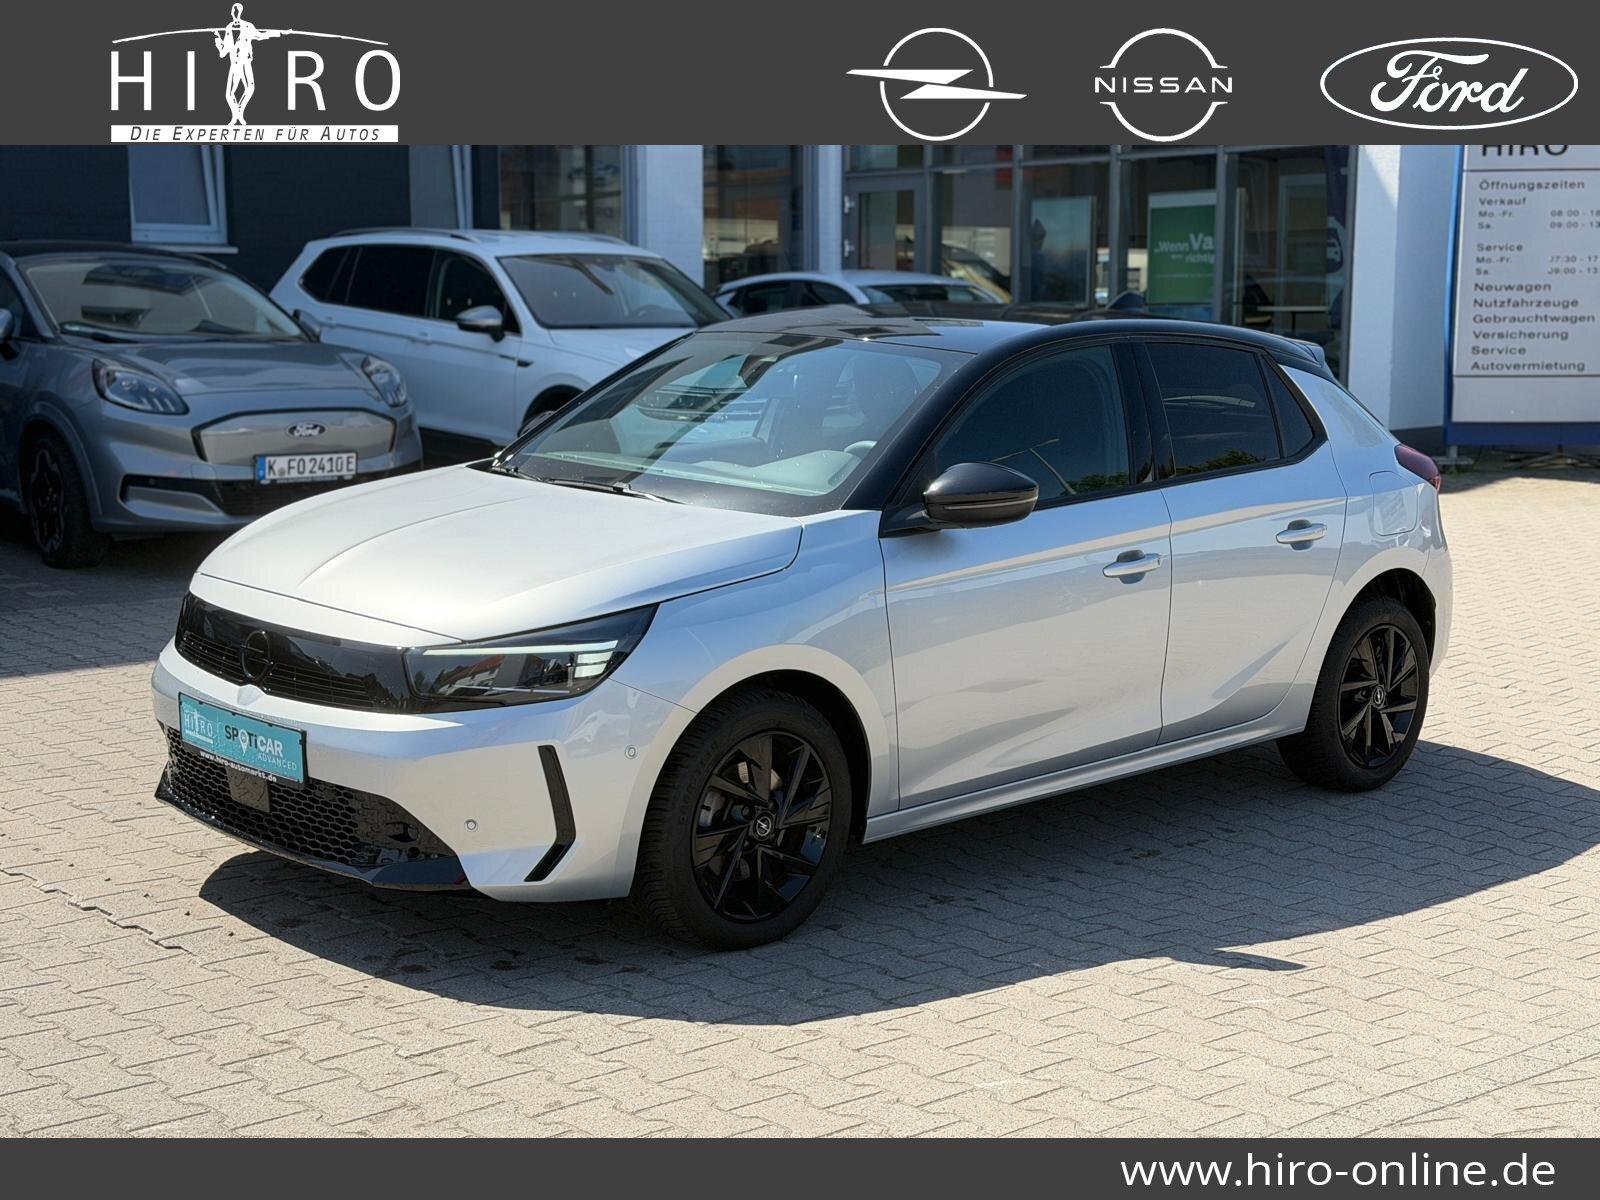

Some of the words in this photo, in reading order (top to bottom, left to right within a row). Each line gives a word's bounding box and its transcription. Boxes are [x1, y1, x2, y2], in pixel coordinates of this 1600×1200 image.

[1479, 178, 1585, 192] Öffnungszeiten
[1479, 197, 1527, 206] Verkauf
[1476, 243, 1524, 252] Service
[1473, 282, 1552, 293] Neuwagen
[1473, 298, 1579, 309] Nutzfahrzeuge
[1472, 313, 1596, 324] Gebrauchtwagen
[1472, 329, 1569, 341] Versicherung
[1471, 345, 1527, 355] Service
[1471, 361, 1586, 372] Autovermietung
[256, 752, 297, 771] ADVANCED
